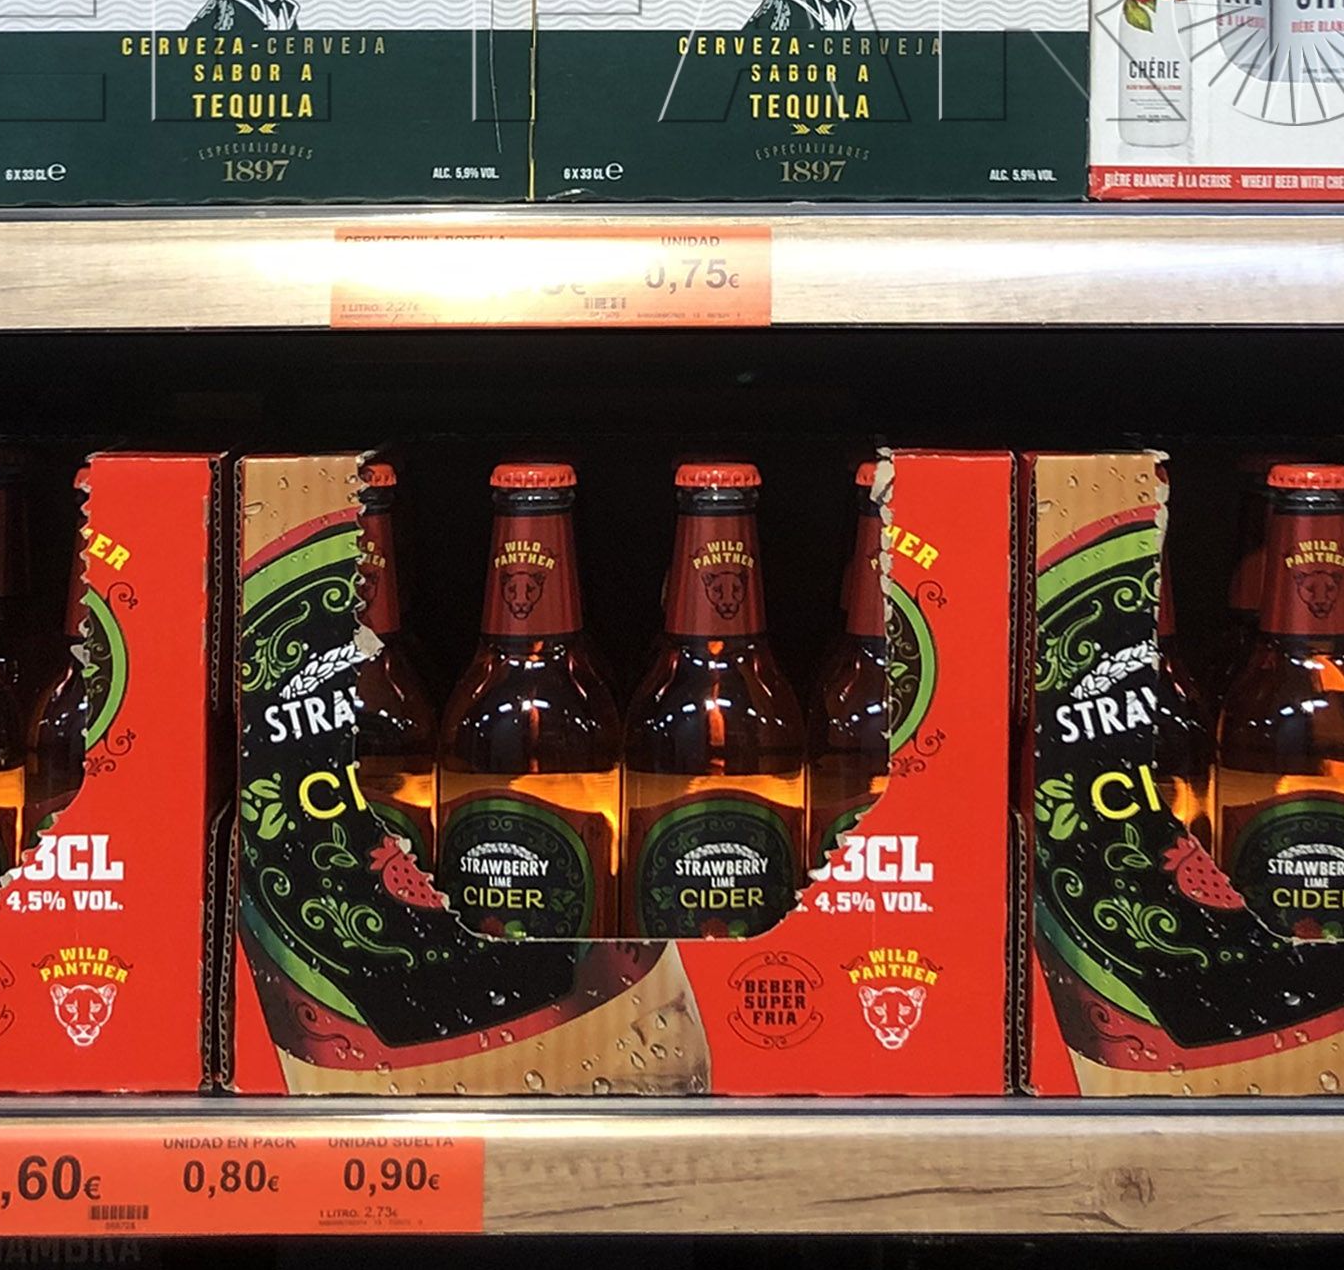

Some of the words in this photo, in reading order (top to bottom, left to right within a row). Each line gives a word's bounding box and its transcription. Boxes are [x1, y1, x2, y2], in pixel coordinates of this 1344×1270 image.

[194, 63, 281, 82] SABOR
[301, 63, 312, 81] A
[751, 64, 837, 82] SABOR
[858, 64, 869, 82] A
[1128, 58, 1180, 81] CHÉRIE
[192, 94, 312, 119] TEQUILA
[750, 94, 869, 119] TEQUILA
[199, 142, 312, 160] ESPECIALIDADES
[223, 160, 290, 182] 1897
[780, 160, 846, 182] 1897
[661, 236, 720, 248] UNIDAD
[460, 855, 549, 877] STRAWBERRY
[6, 890, 66, 913] 4,5%
[73, 890, 123, 910] VOL.
[463, 887, 545, 909] CIDER
[814, 891, 875, 914] 4,5%
[882, 891, 933, 912] VOL.
[59, 947, 109, 962] WILD
[41, 961, 129, 984] PANTHER
[163, 1137, 223, 1149] UNIDAD
[228, 1137, 248, 1148] EN
[252, 1137, 296, 1148] PACK
[183, 1159, 279, 1199] 0,80€
[344, 1158, 440, 1197] 0,90€
